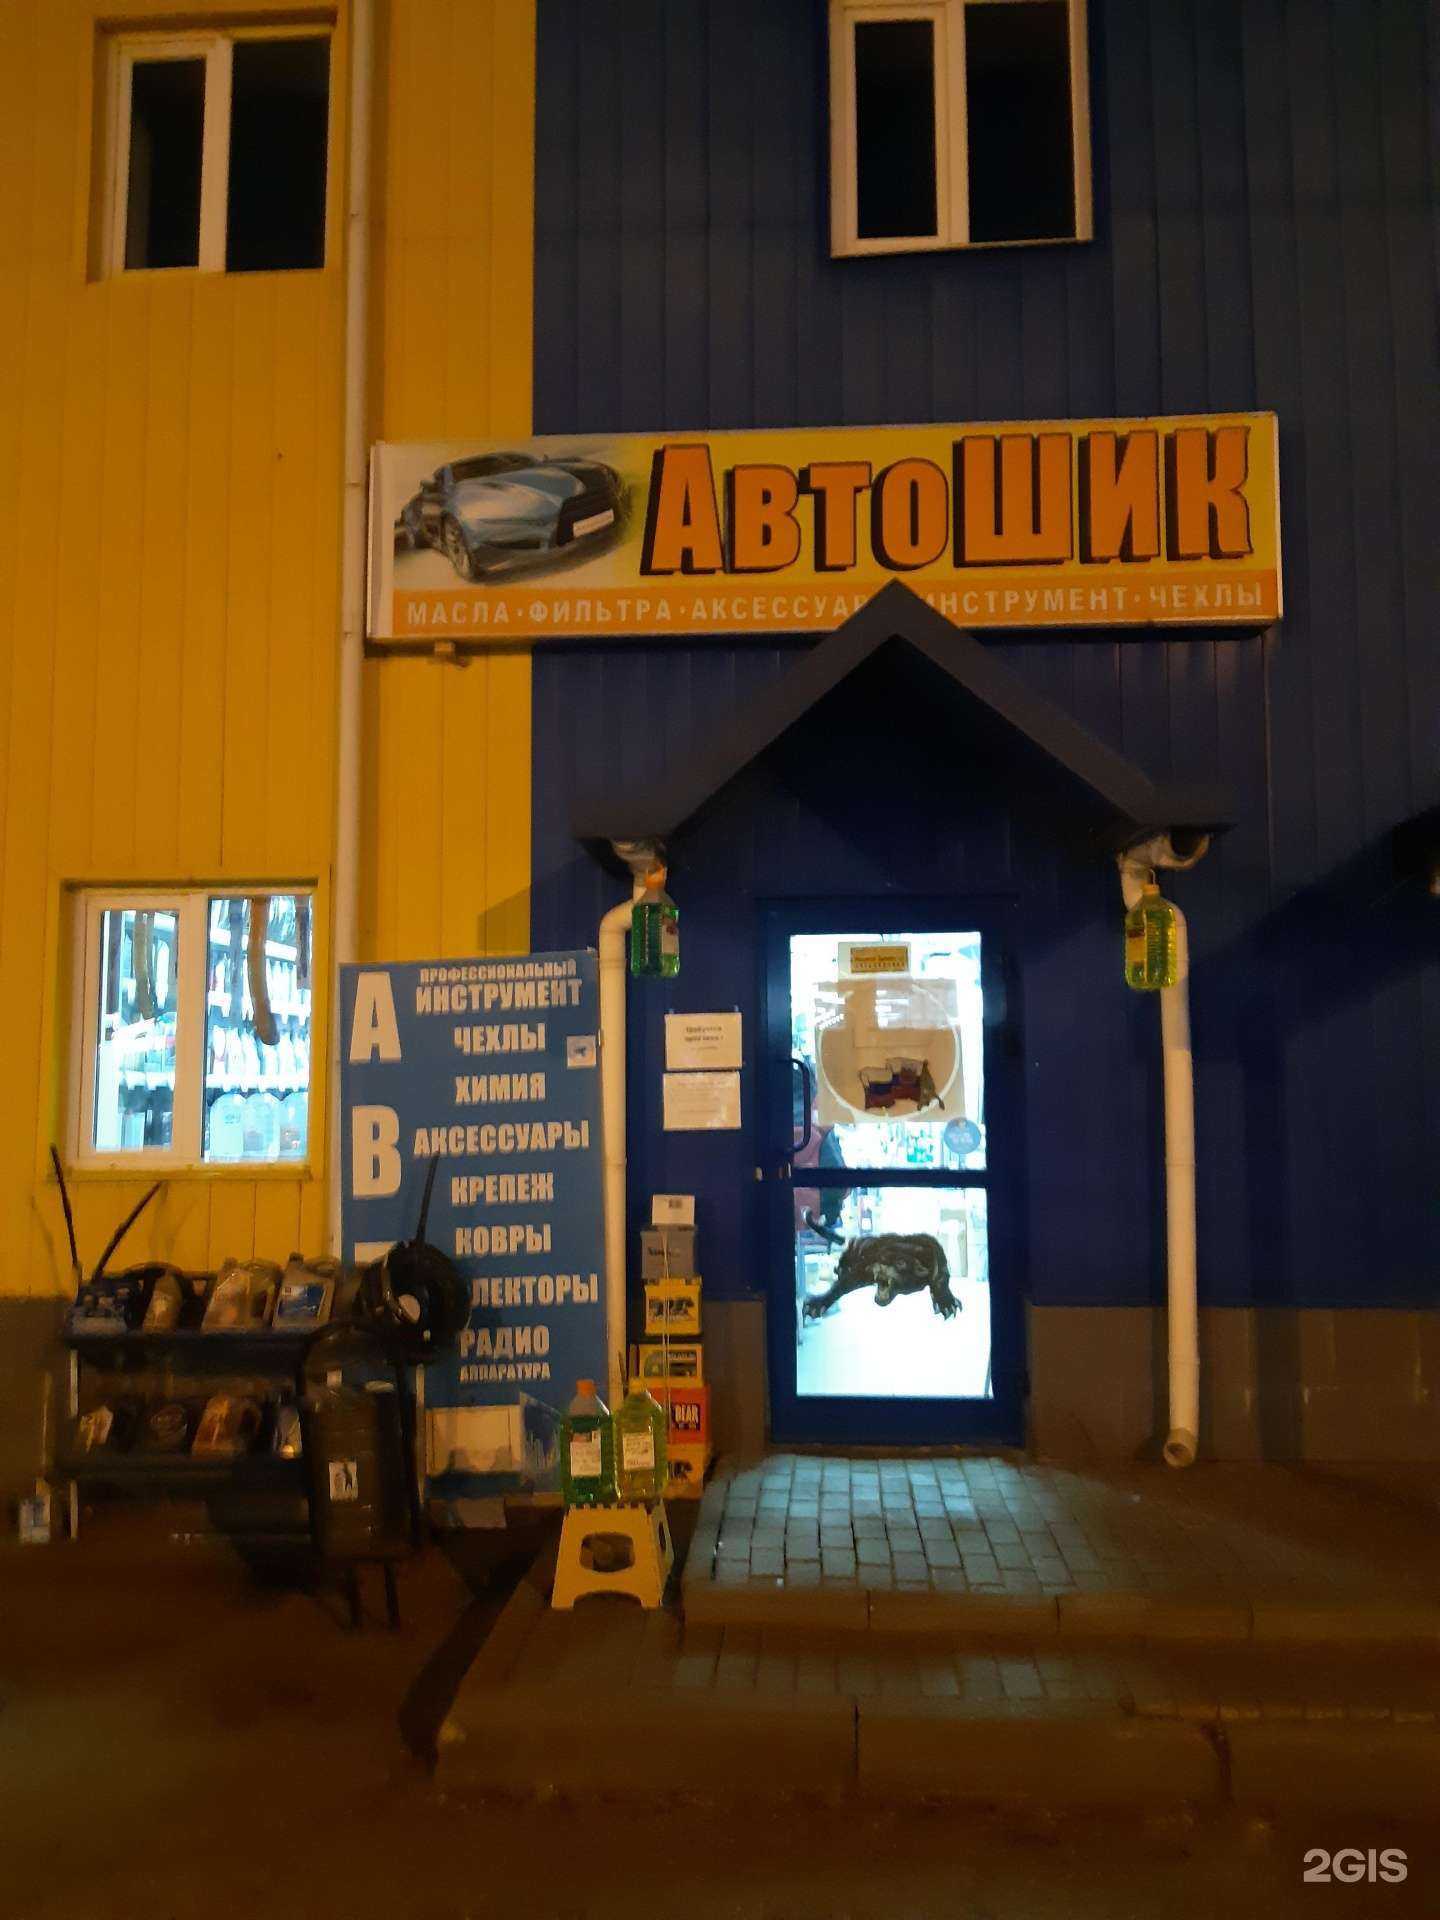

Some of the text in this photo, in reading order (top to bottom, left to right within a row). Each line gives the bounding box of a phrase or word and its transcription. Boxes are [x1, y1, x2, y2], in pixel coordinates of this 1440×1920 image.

[691, 593, 870, 620] АКСЕССУАР
[419, 959, 578, 984] ПРОФЕССИОНАЛЬНЫЙ
[415, 979, 583, 1016] ИНСТРУМЕНТ
[454, 1022, 546, 1056] ЧЕХЛЫ
[455, 1072, 546, 1104] ХИМИЯ
[413, 1120, 590, 1157] АКСЕССУАРЫ
[451, 1172, 555, 1206] КРЕПЕЖ
[455, 1224, 552, 1256] КОВРЫ
[459, 1325, 551, 1360] РАДИО
[459, 1363, 551, 1383] АППАРАТУРА
